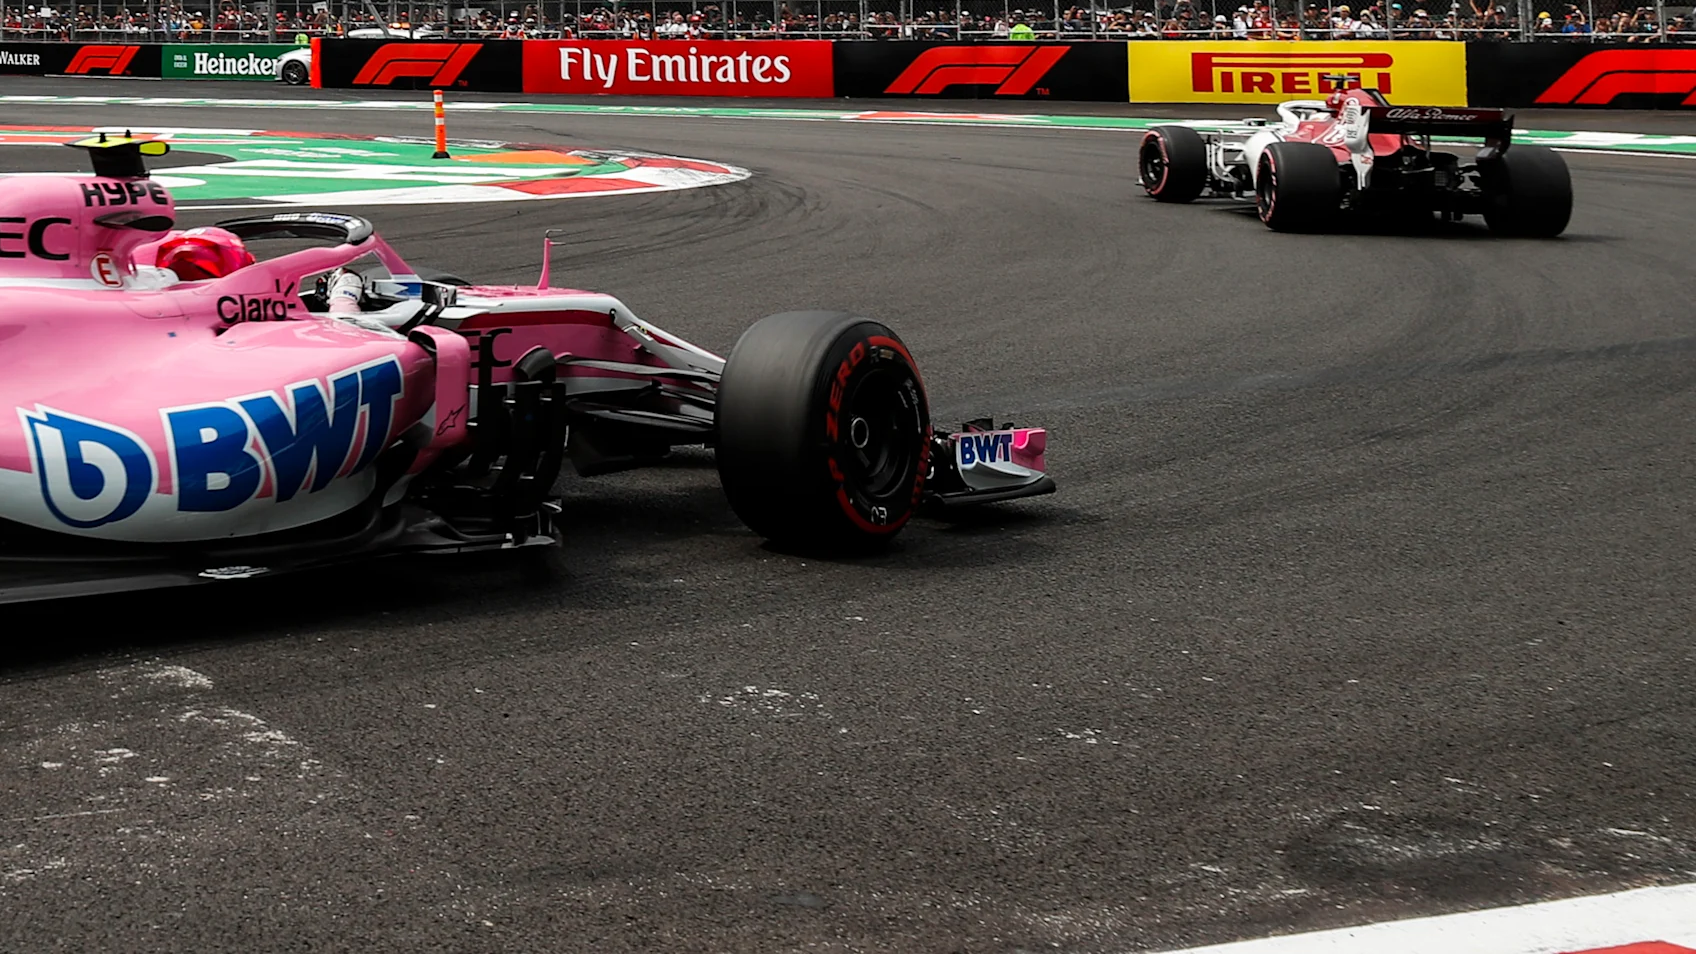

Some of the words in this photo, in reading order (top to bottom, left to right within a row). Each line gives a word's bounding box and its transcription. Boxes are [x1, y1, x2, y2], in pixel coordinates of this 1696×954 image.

[559, 46, 618, 88] Fly
[627, 47, 791, 84] Emirates
[1191, 52, 1394, 94] PIRELLI
[80, 182, 168, 208] HYPE
[217, 295, 289, 325] Claro
[162, 356, 402, 514] BWT
[960, 433, 1012, 466] BWT
